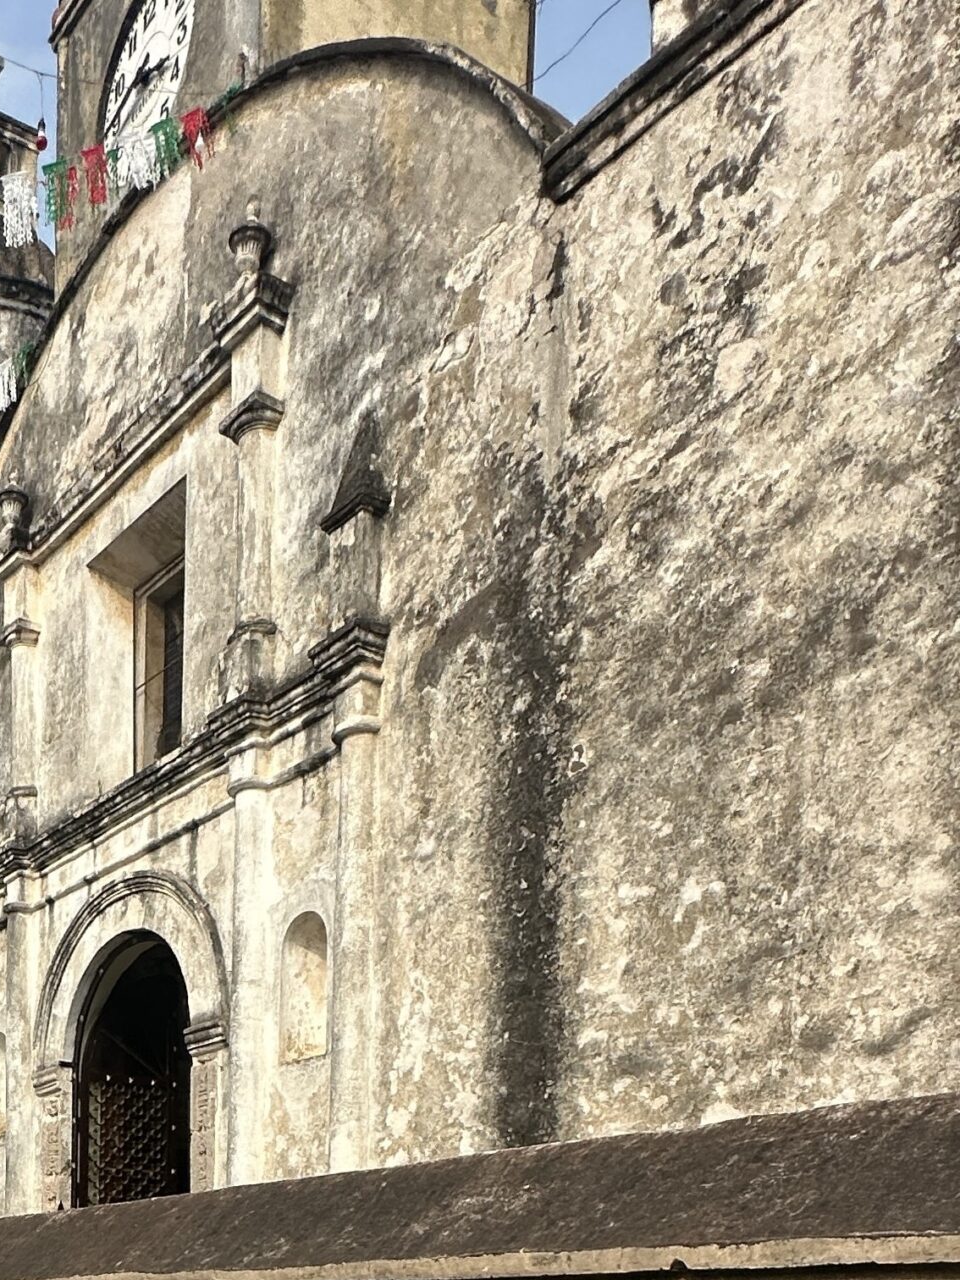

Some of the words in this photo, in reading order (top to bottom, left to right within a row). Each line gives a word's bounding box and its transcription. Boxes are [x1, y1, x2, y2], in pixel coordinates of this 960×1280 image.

[128, 29, 138, 60] 11
[177, 14, 187, 45] 3
[170, 55, 180, 82] 4
[114, 73, 125, 104] 10
